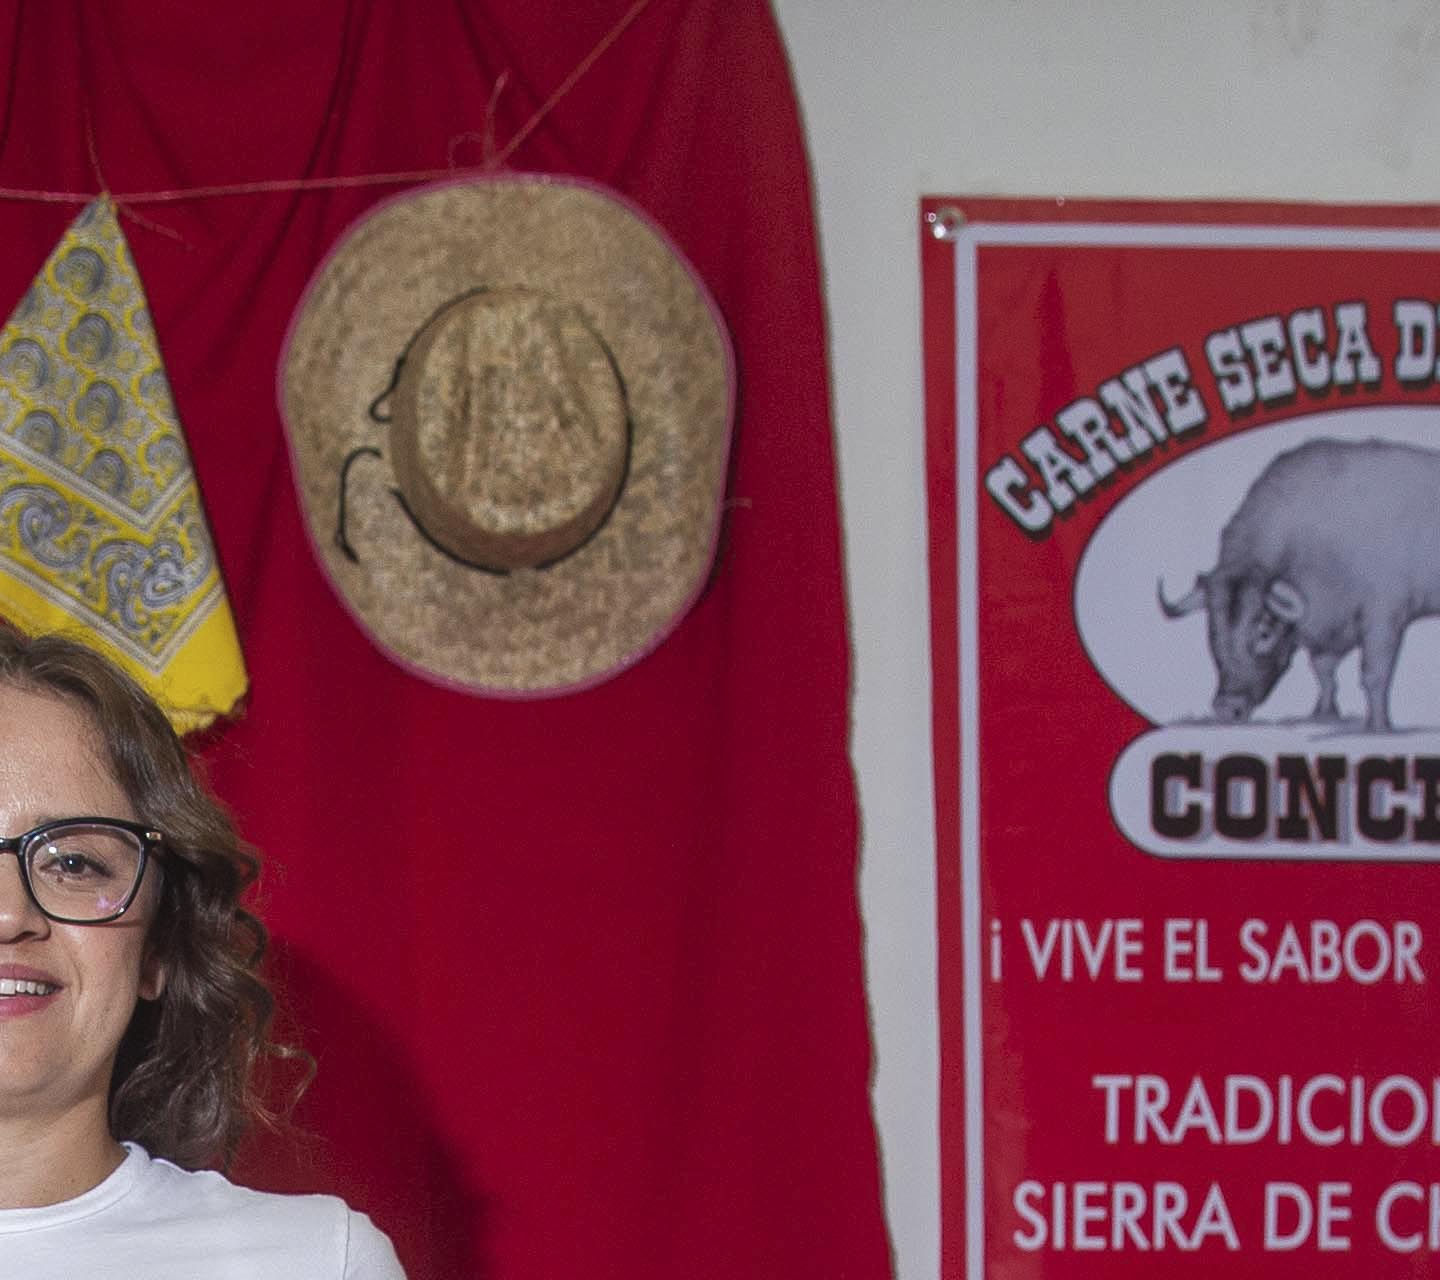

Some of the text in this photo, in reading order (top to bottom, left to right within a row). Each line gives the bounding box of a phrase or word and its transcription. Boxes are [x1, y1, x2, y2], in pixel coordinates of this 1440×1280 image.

[986, 350, 1210, 534] CARNE
[1206, 301, 1382, 412] SECA
[1021, 919, 1143, 981] VIVE
[1164, 919, 1222, 981] EL
[1240, 919, 1424, 984] SABOR
[1013, 1180, 1239, 1251] SIERRA
[1264, 1182, 1351, 1250] DE
